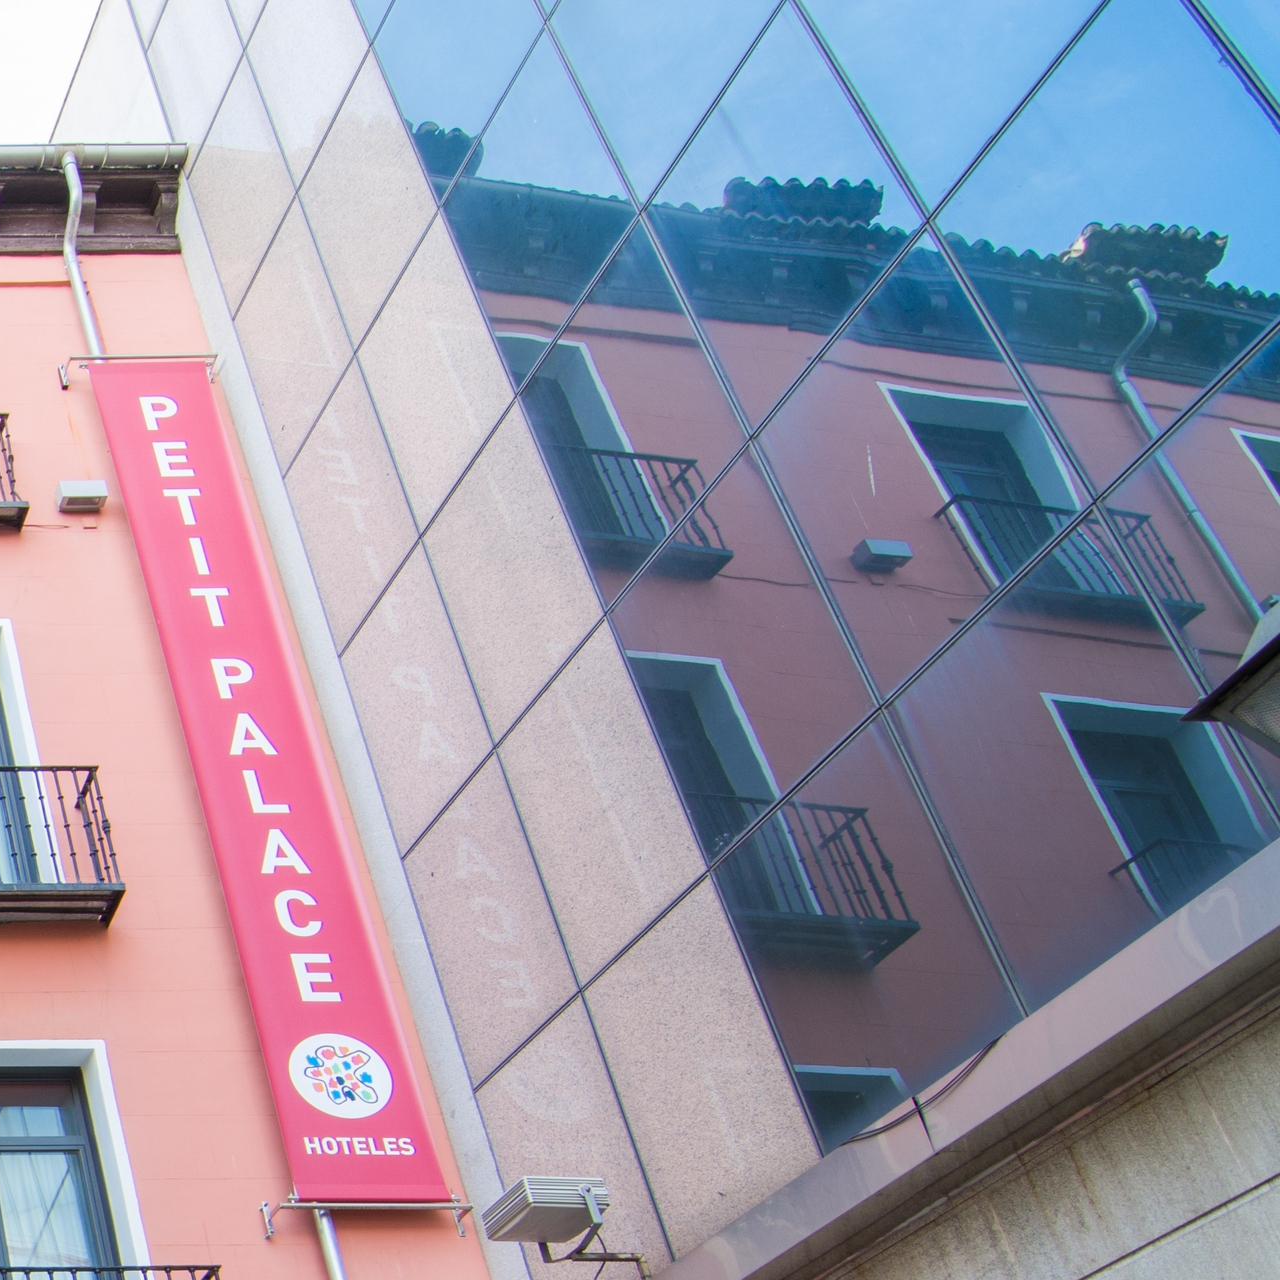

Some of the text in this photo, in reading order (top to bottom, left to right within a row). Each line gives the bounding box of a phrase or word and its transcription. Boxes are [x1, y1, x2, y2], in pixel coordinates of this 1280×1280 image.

[139, 396, 343, 1002] PETIT PALACE
[303, 1136, 416, 1156] HOTELES
